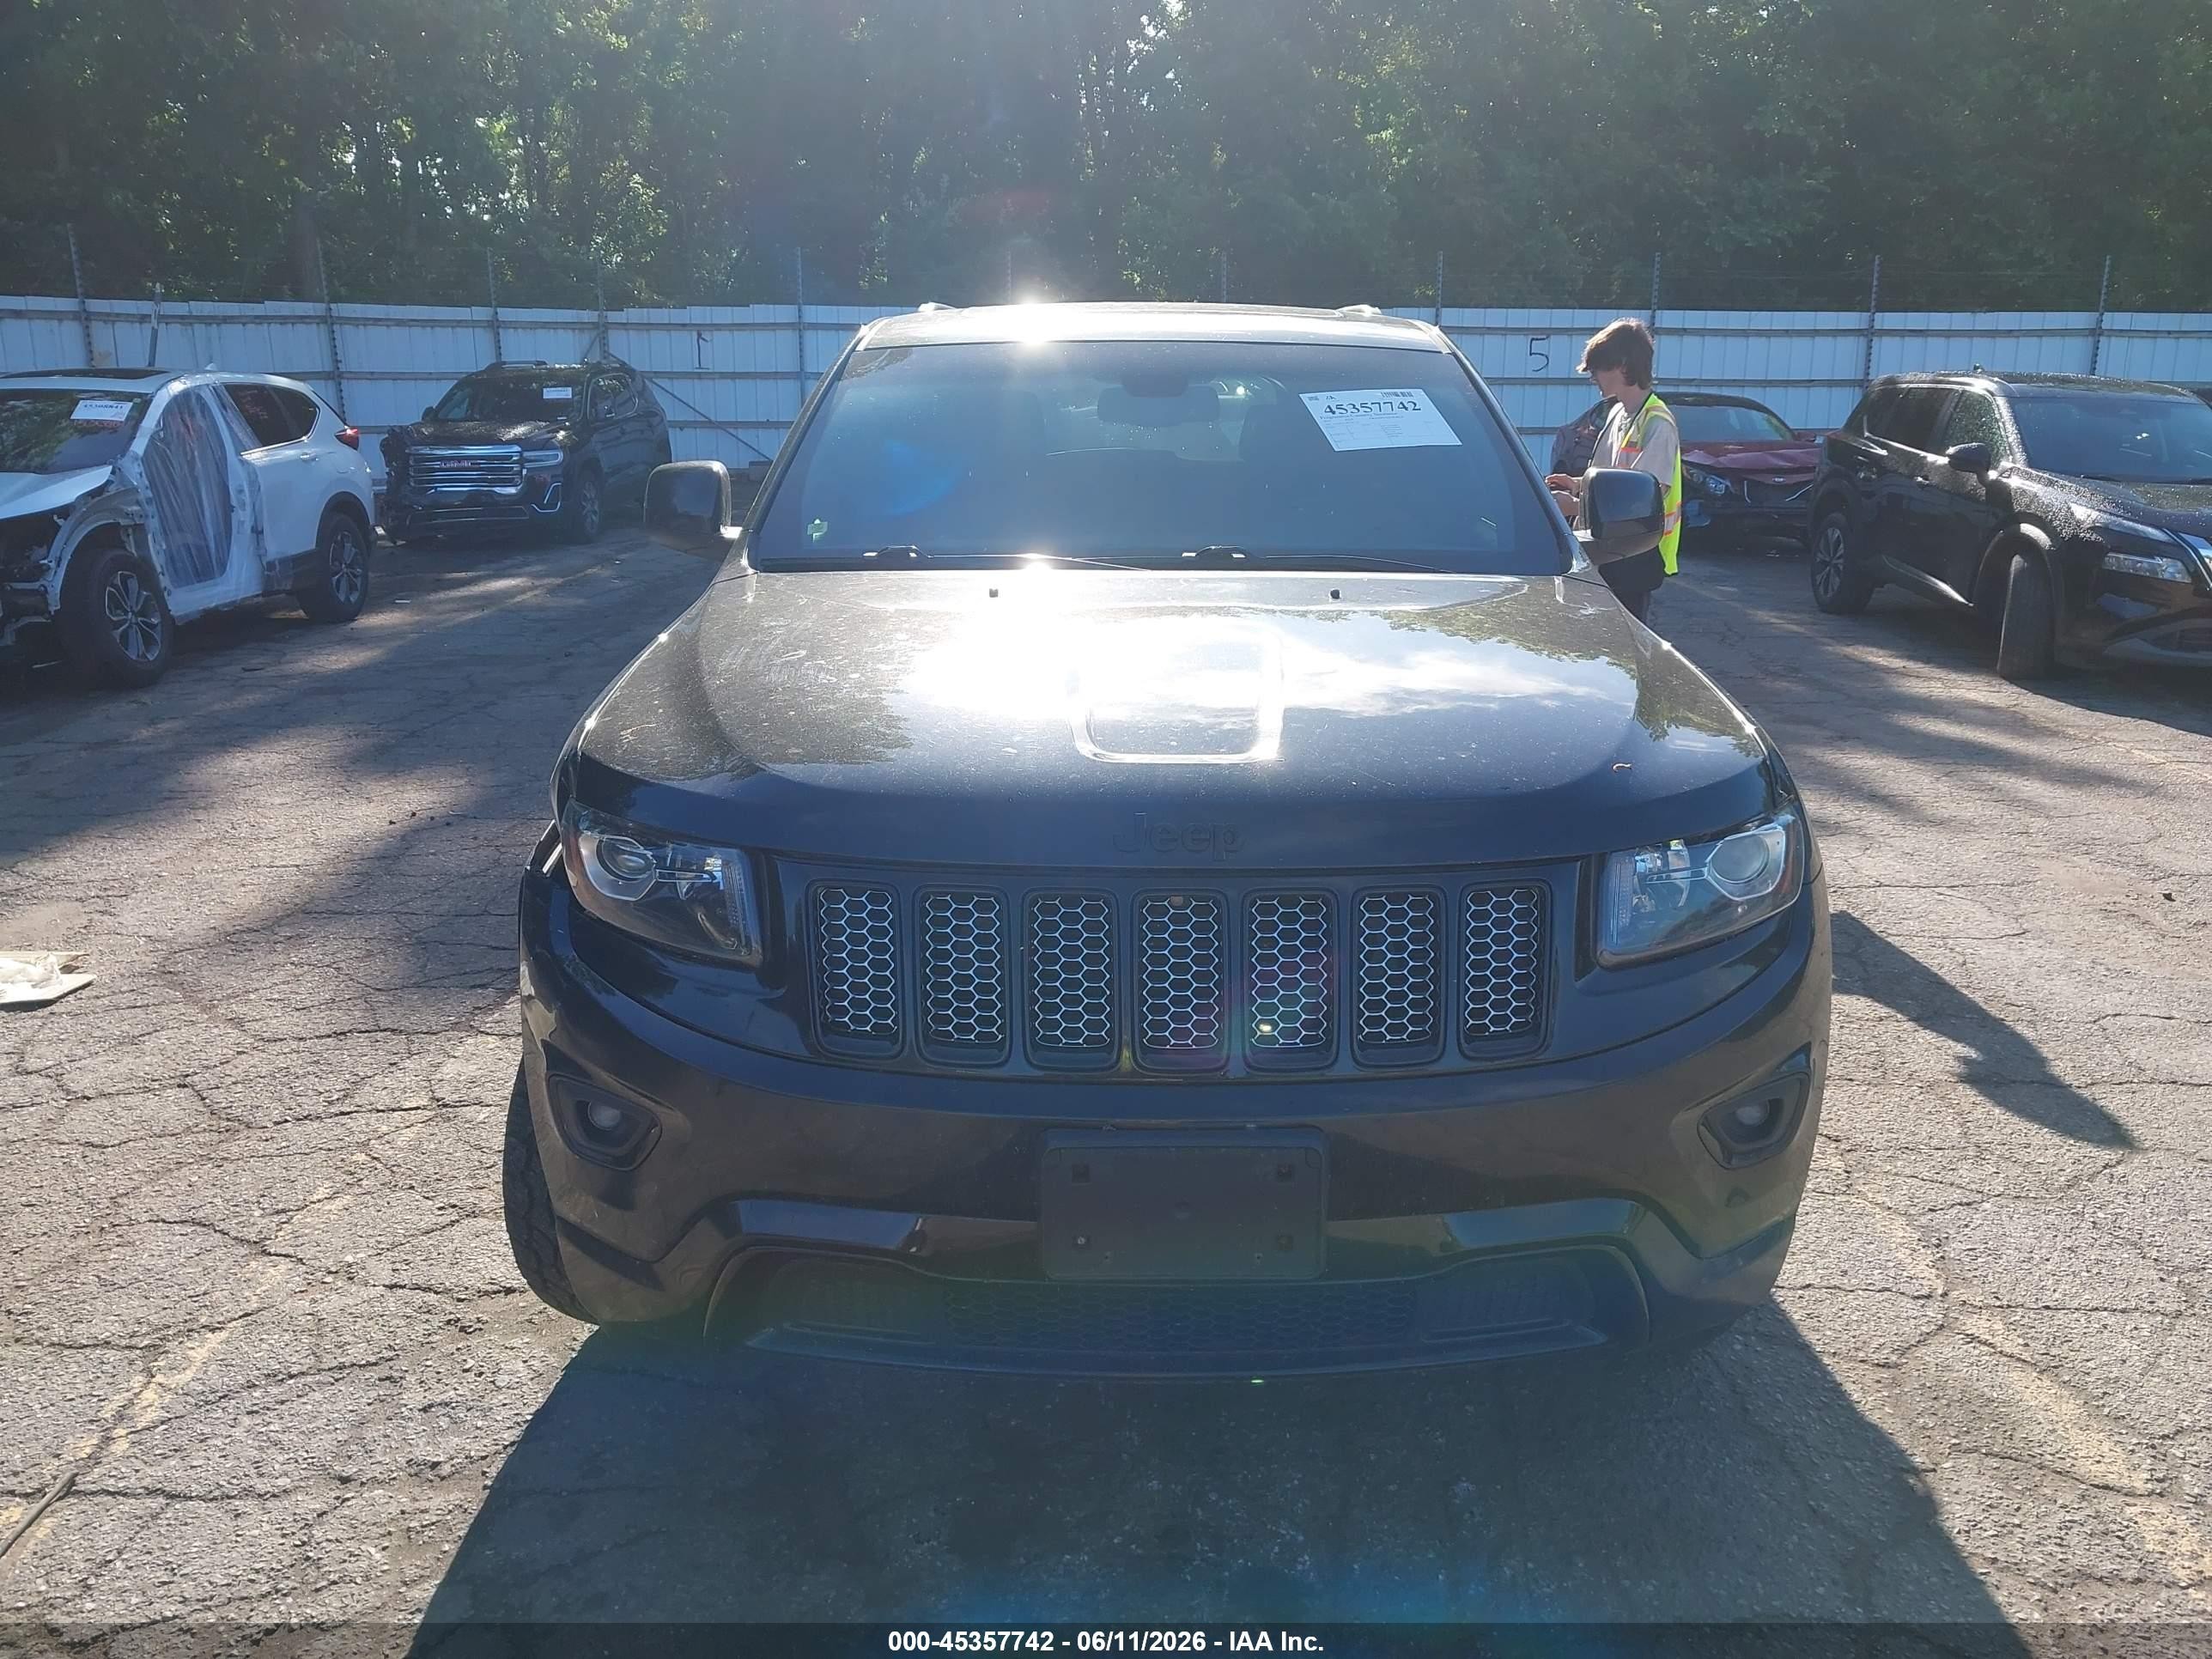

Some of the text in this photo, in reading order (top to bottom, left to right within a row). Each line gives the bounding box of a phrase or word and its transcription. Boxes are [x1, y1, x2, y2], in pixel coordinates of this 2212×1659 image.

[1528, 336, 1550, 373] 5
[1323, 400, 1422, 416] 45357742
[1112, 811, 1247, 862] Jeep
